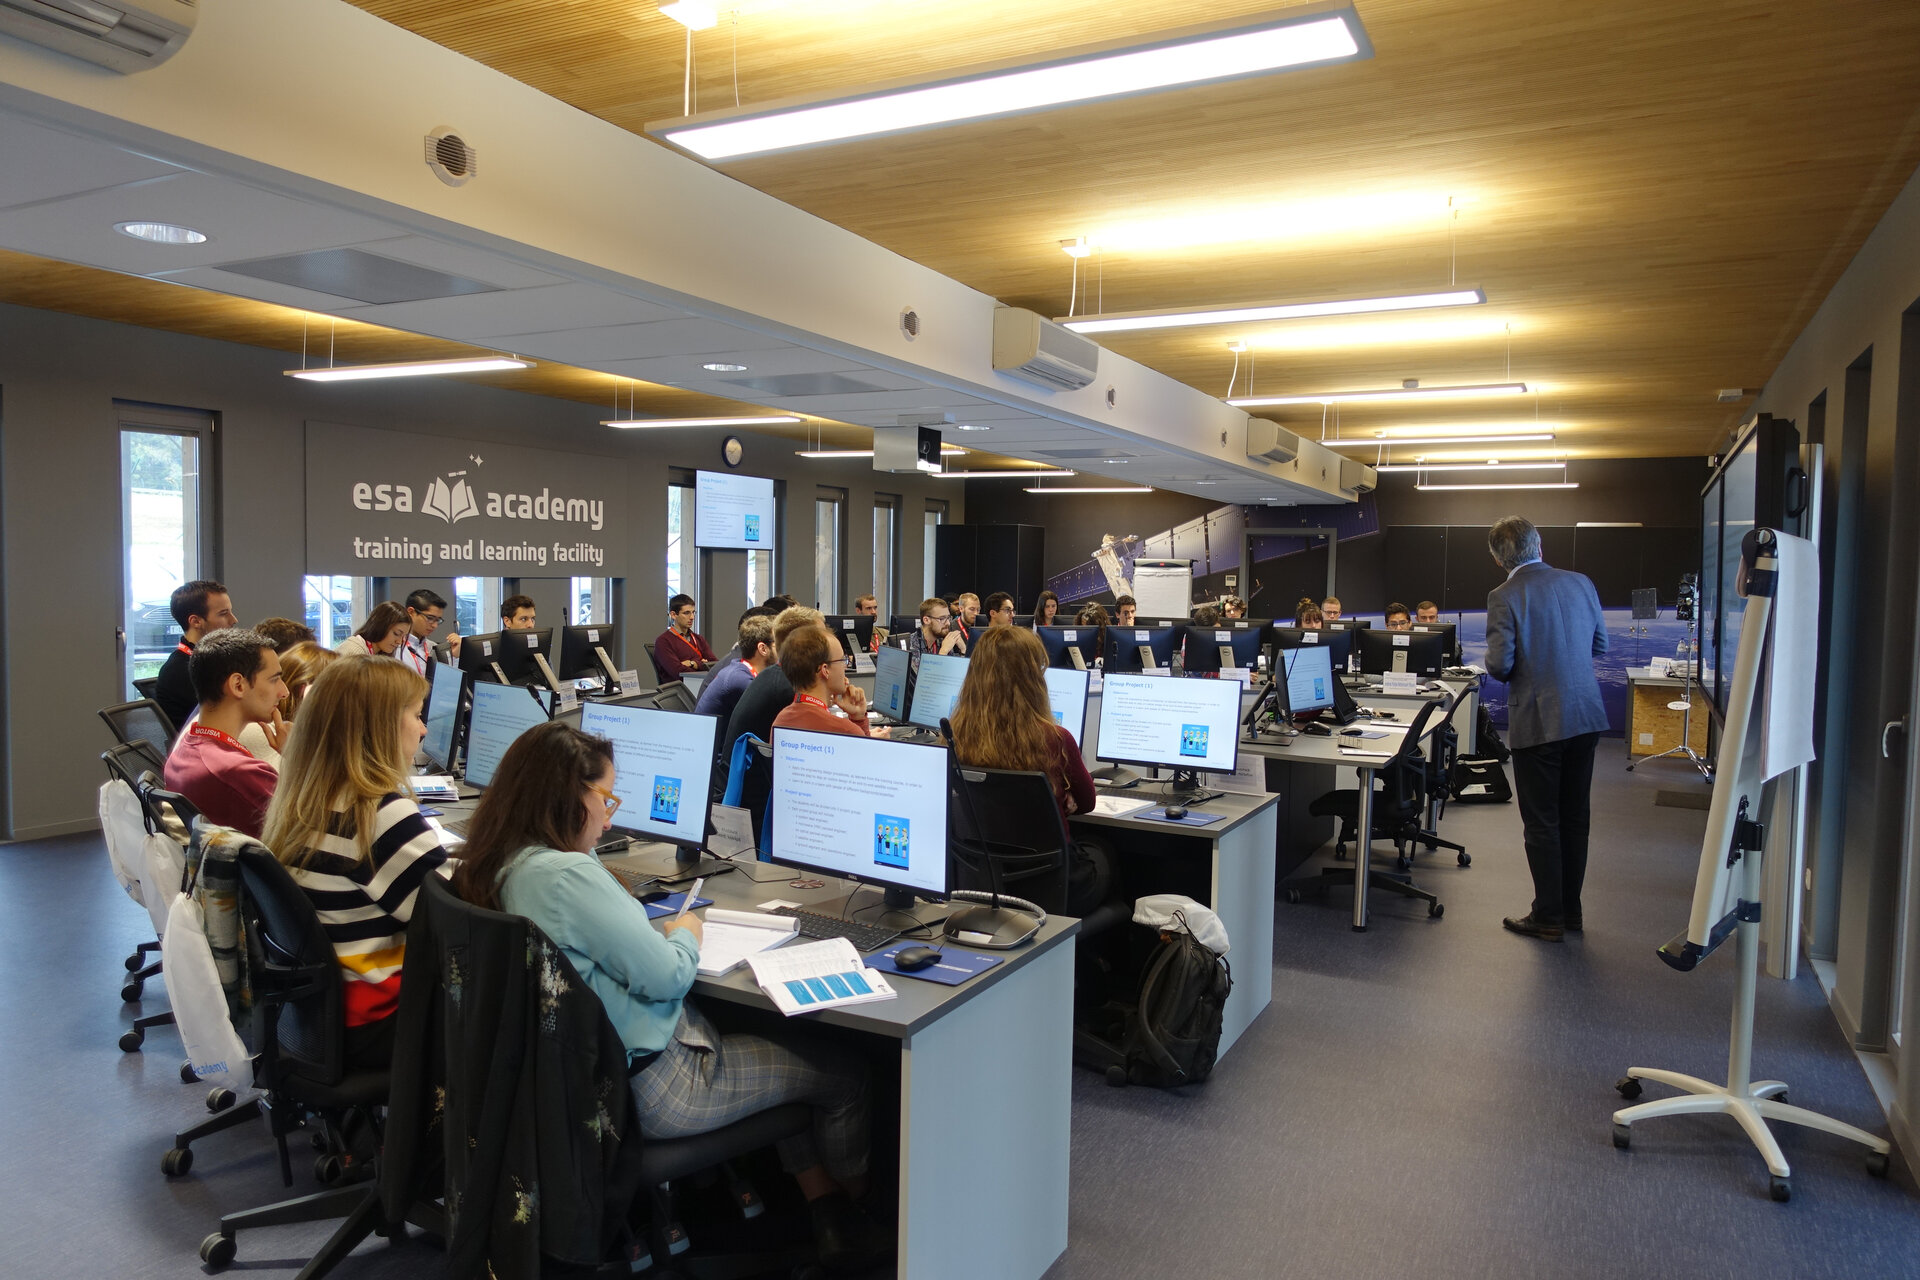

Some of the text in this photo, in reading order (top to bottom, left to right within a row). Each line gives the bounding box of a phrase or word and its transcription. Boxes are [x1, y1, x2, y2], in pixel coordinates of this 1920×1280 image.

[353, 482, 604, 531] esa academy
[354, 536, 604, 566] training and learning facility
[588, 712, 603, 721] Group
[604, 714, 621, 723] Project
[195, 727, 221, 738] VISITOR
[780, 740, 835, 755] Group Project (1)
